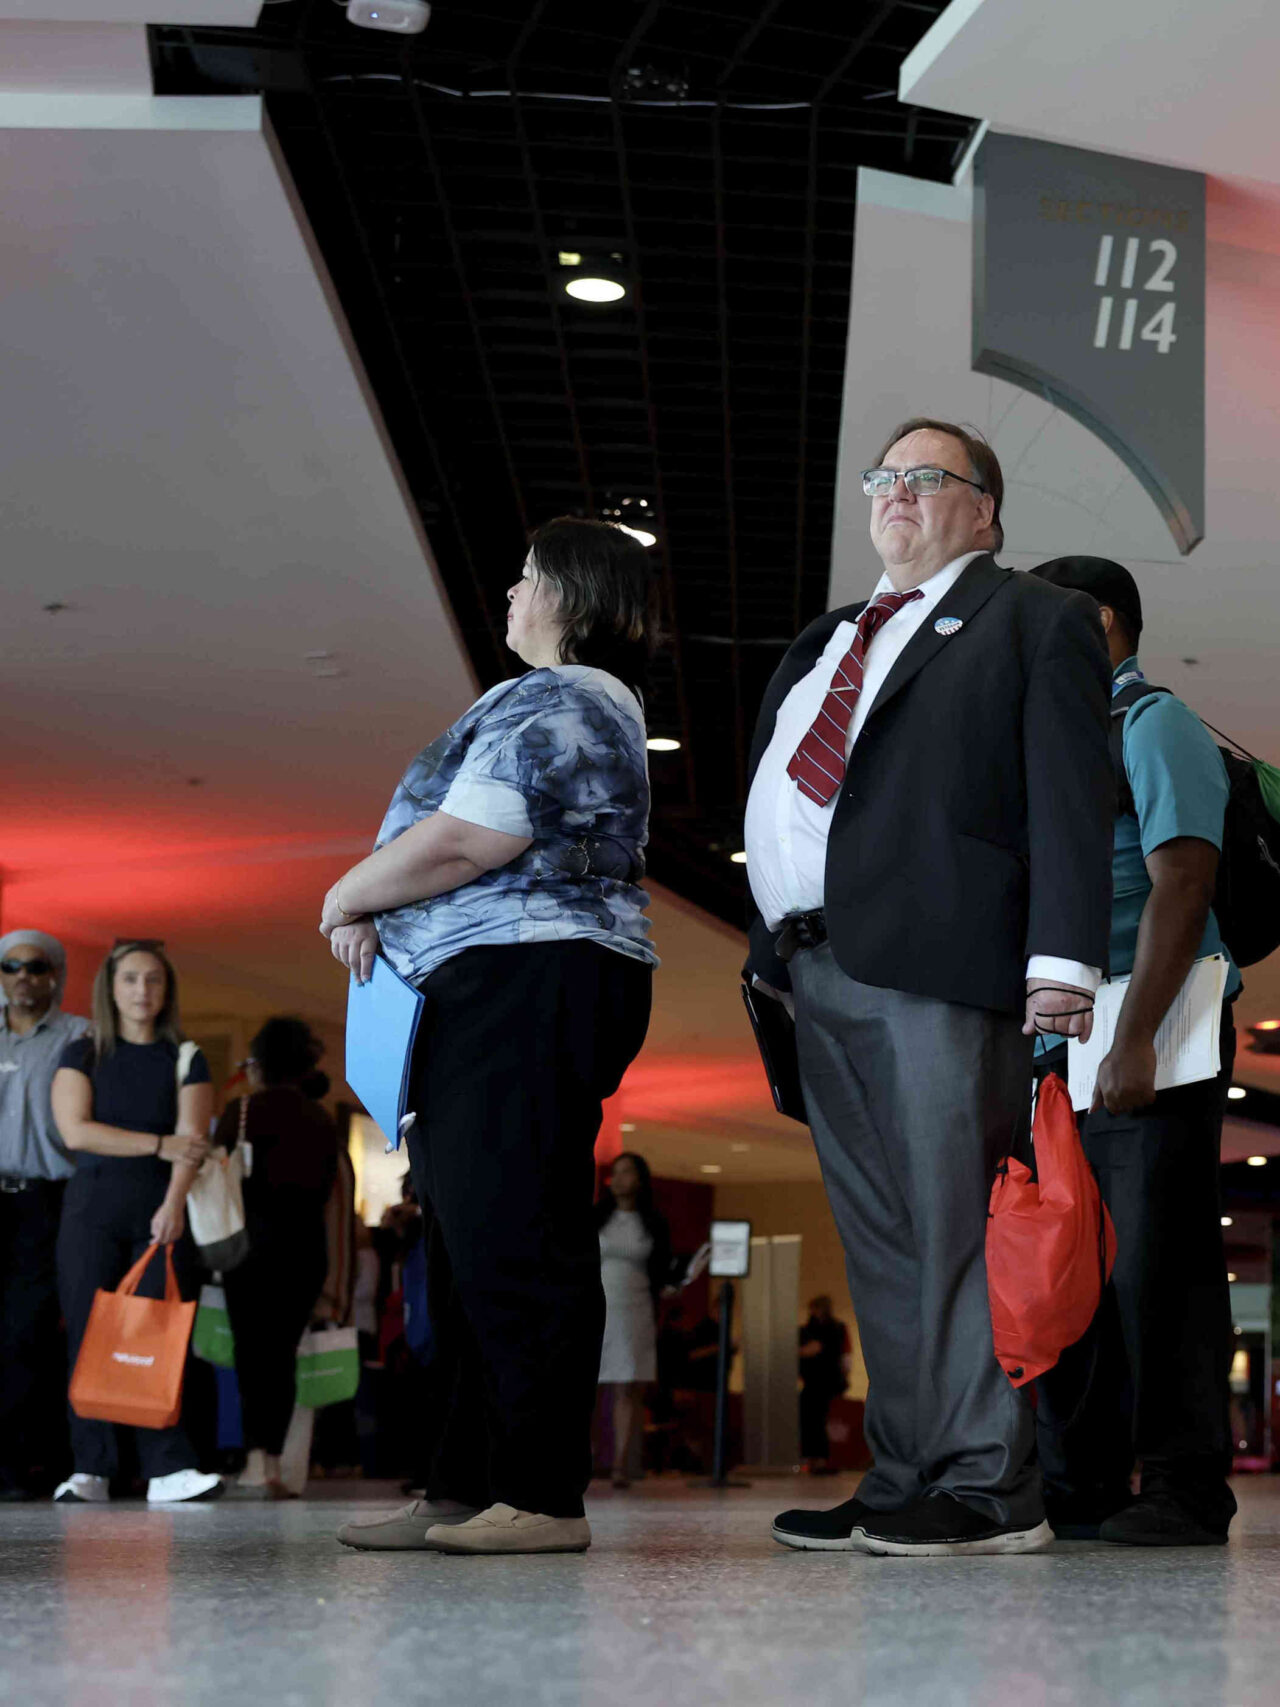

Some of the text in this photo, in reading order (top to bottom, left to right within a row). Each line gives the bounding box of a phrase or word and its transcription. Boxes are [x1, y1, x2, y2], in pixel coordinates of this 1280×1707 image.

[1038, 199, 1190, 232] SECTIONS
[1094, 235, 1178, 292] 112
[1094, 296, 1177, 354] 114
